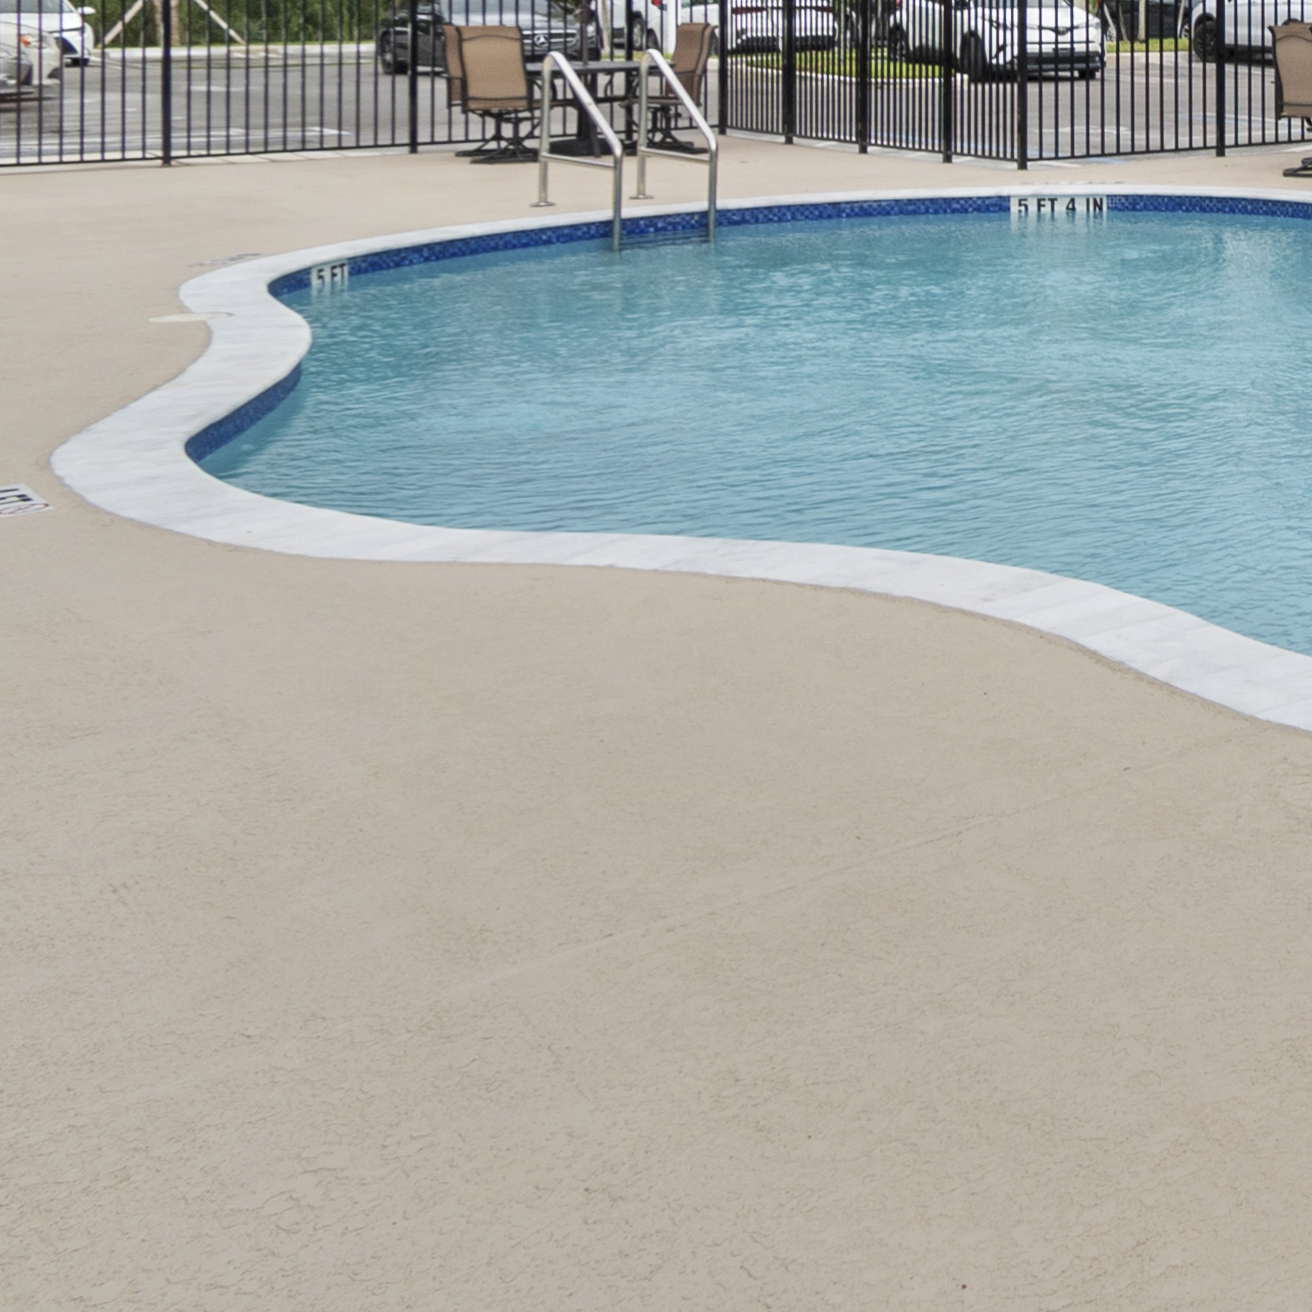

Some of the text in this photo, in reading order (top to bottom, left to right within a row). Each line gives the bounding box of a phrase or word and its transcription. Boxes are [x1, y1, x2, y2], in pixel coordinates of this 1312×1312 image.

[1018, 198, 1103, 212] 5 FT 4 IN
[331, 263, 346, 280] FT
